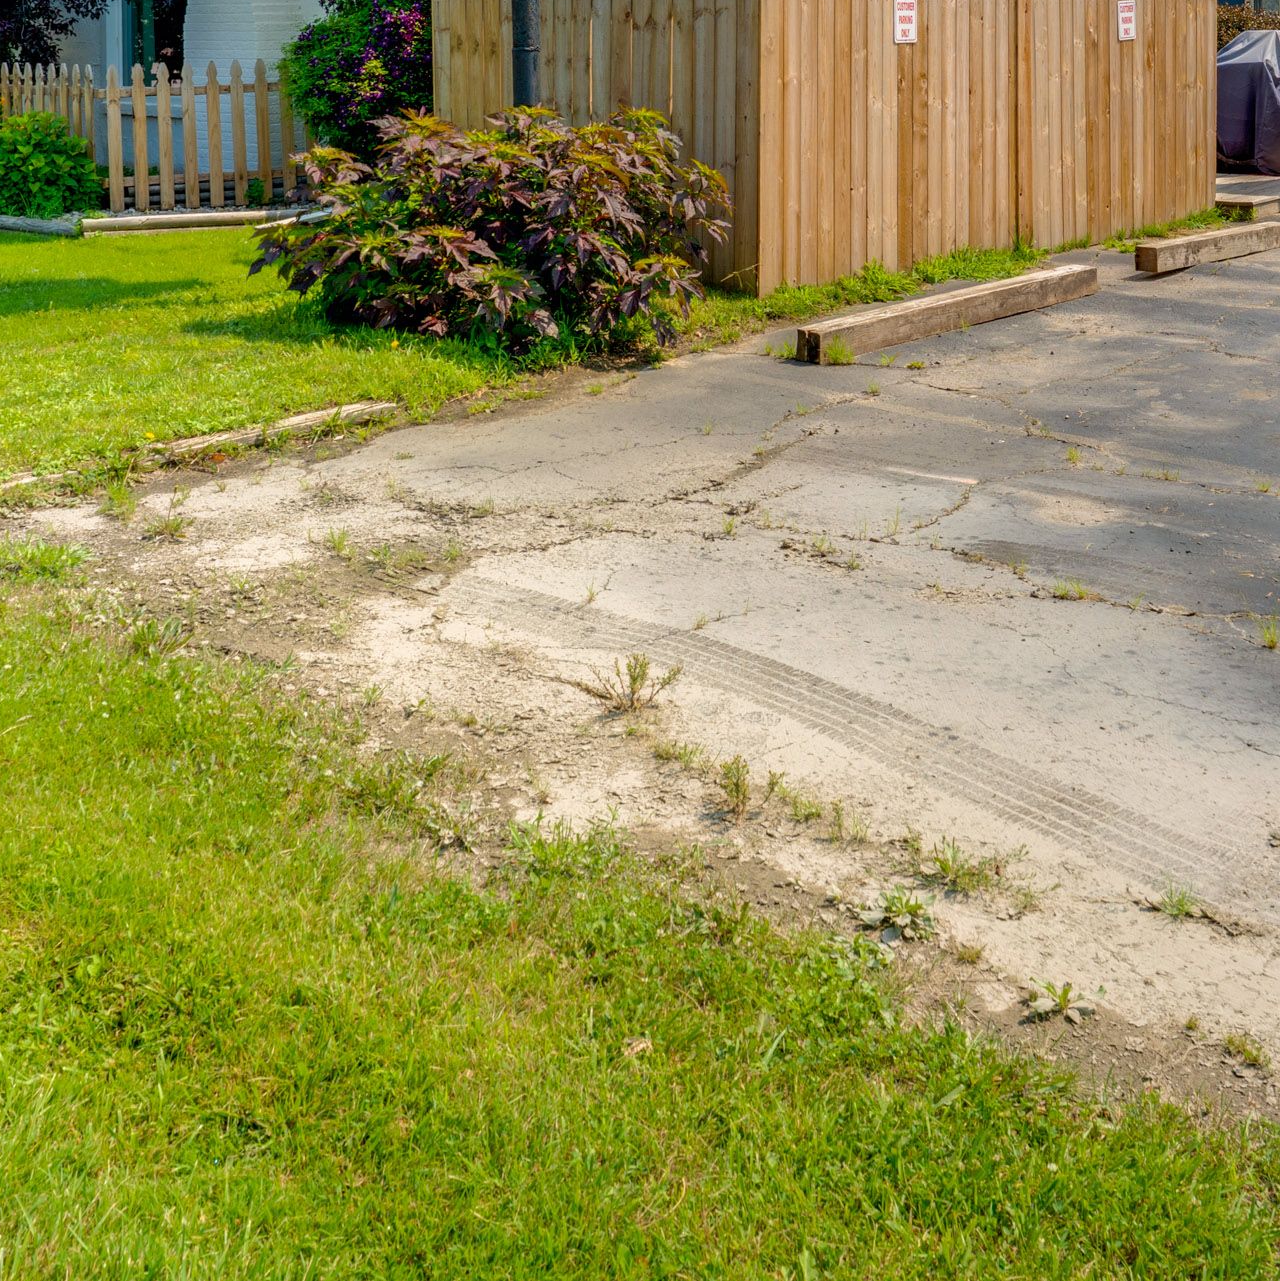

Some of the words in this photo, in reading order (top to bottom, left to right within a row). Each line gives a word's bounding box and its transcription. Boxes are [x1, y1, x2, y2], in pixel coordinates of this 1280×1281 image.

[897, 2, 914, 11] CUSTOMER
[898, 15, 913, 24] PARKING
[901, 28, 910, 38] ONLY
